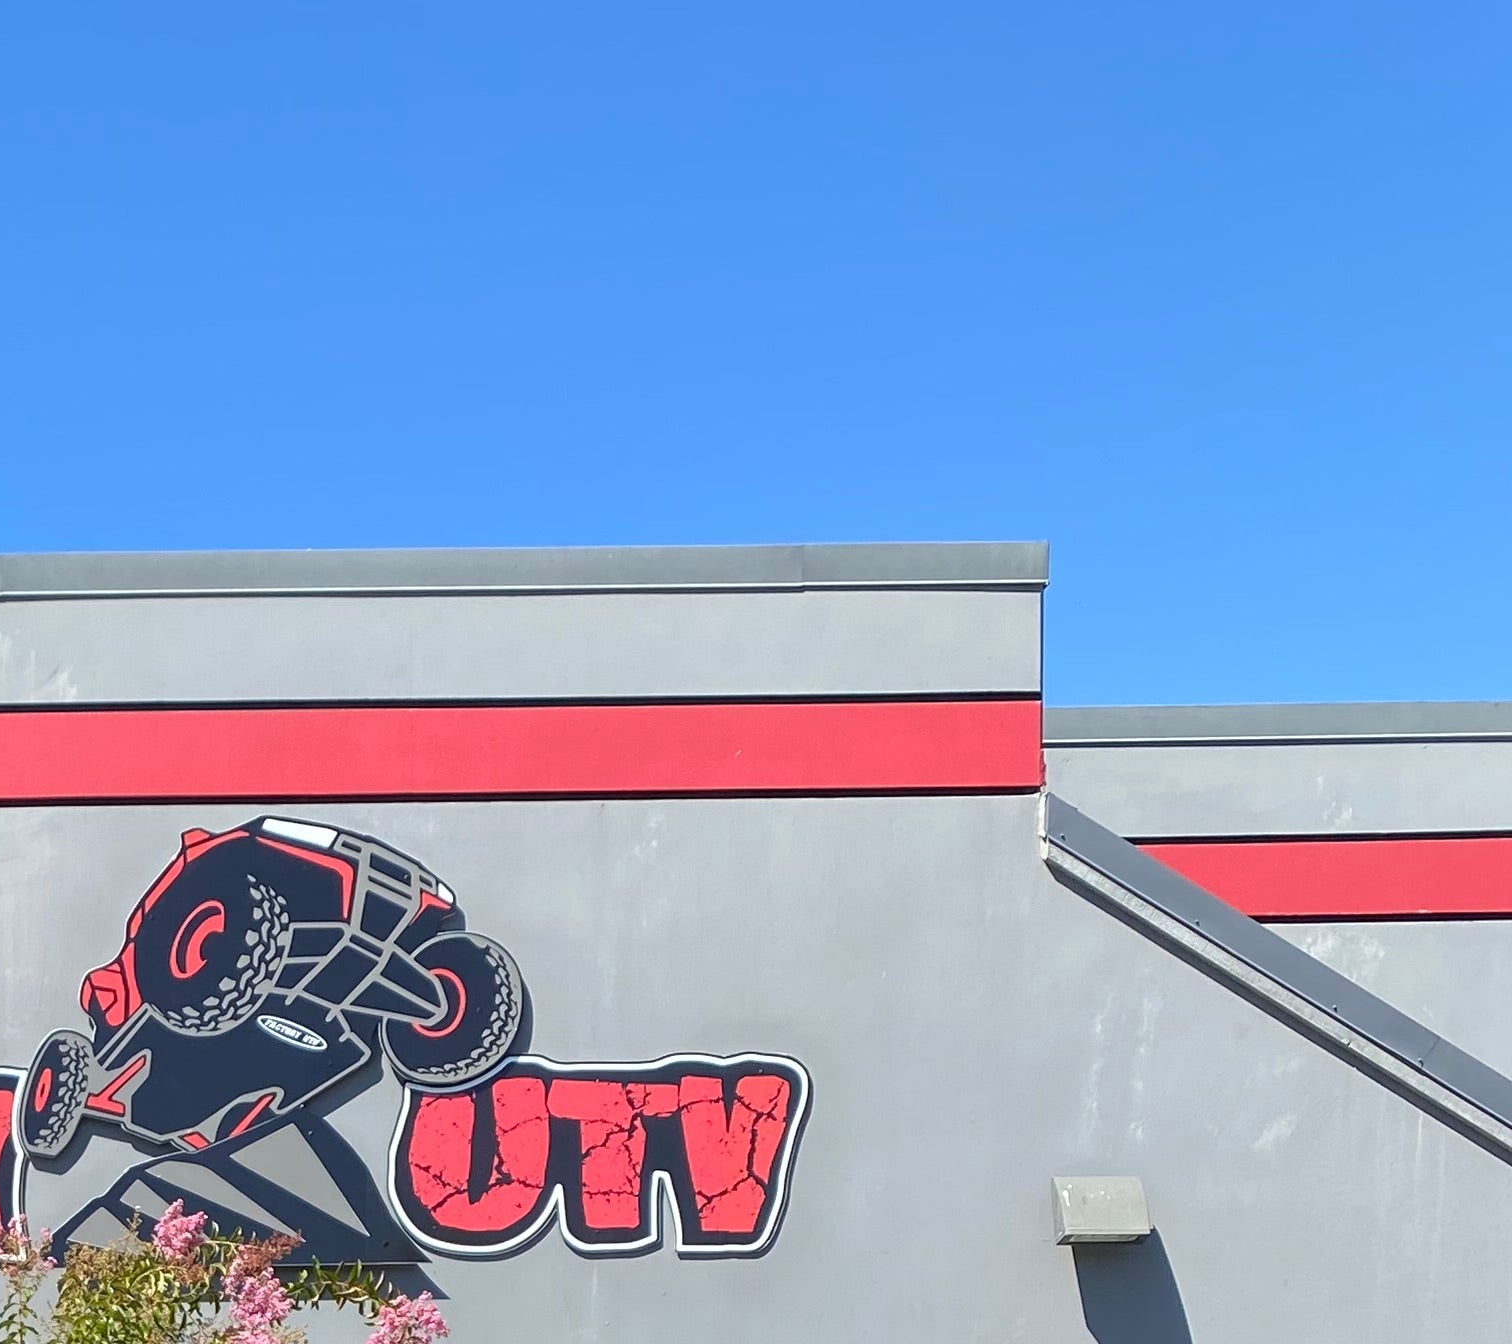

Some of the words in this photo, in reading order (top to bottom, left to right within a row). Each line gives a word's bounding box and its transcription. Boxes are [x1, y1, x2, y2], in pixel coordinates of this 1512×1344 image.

[264, 1019, 303, 1039] FACTORY
[302, 1034, 321, 1046] UTV
[407, 1075, 792, 1233] UTV
